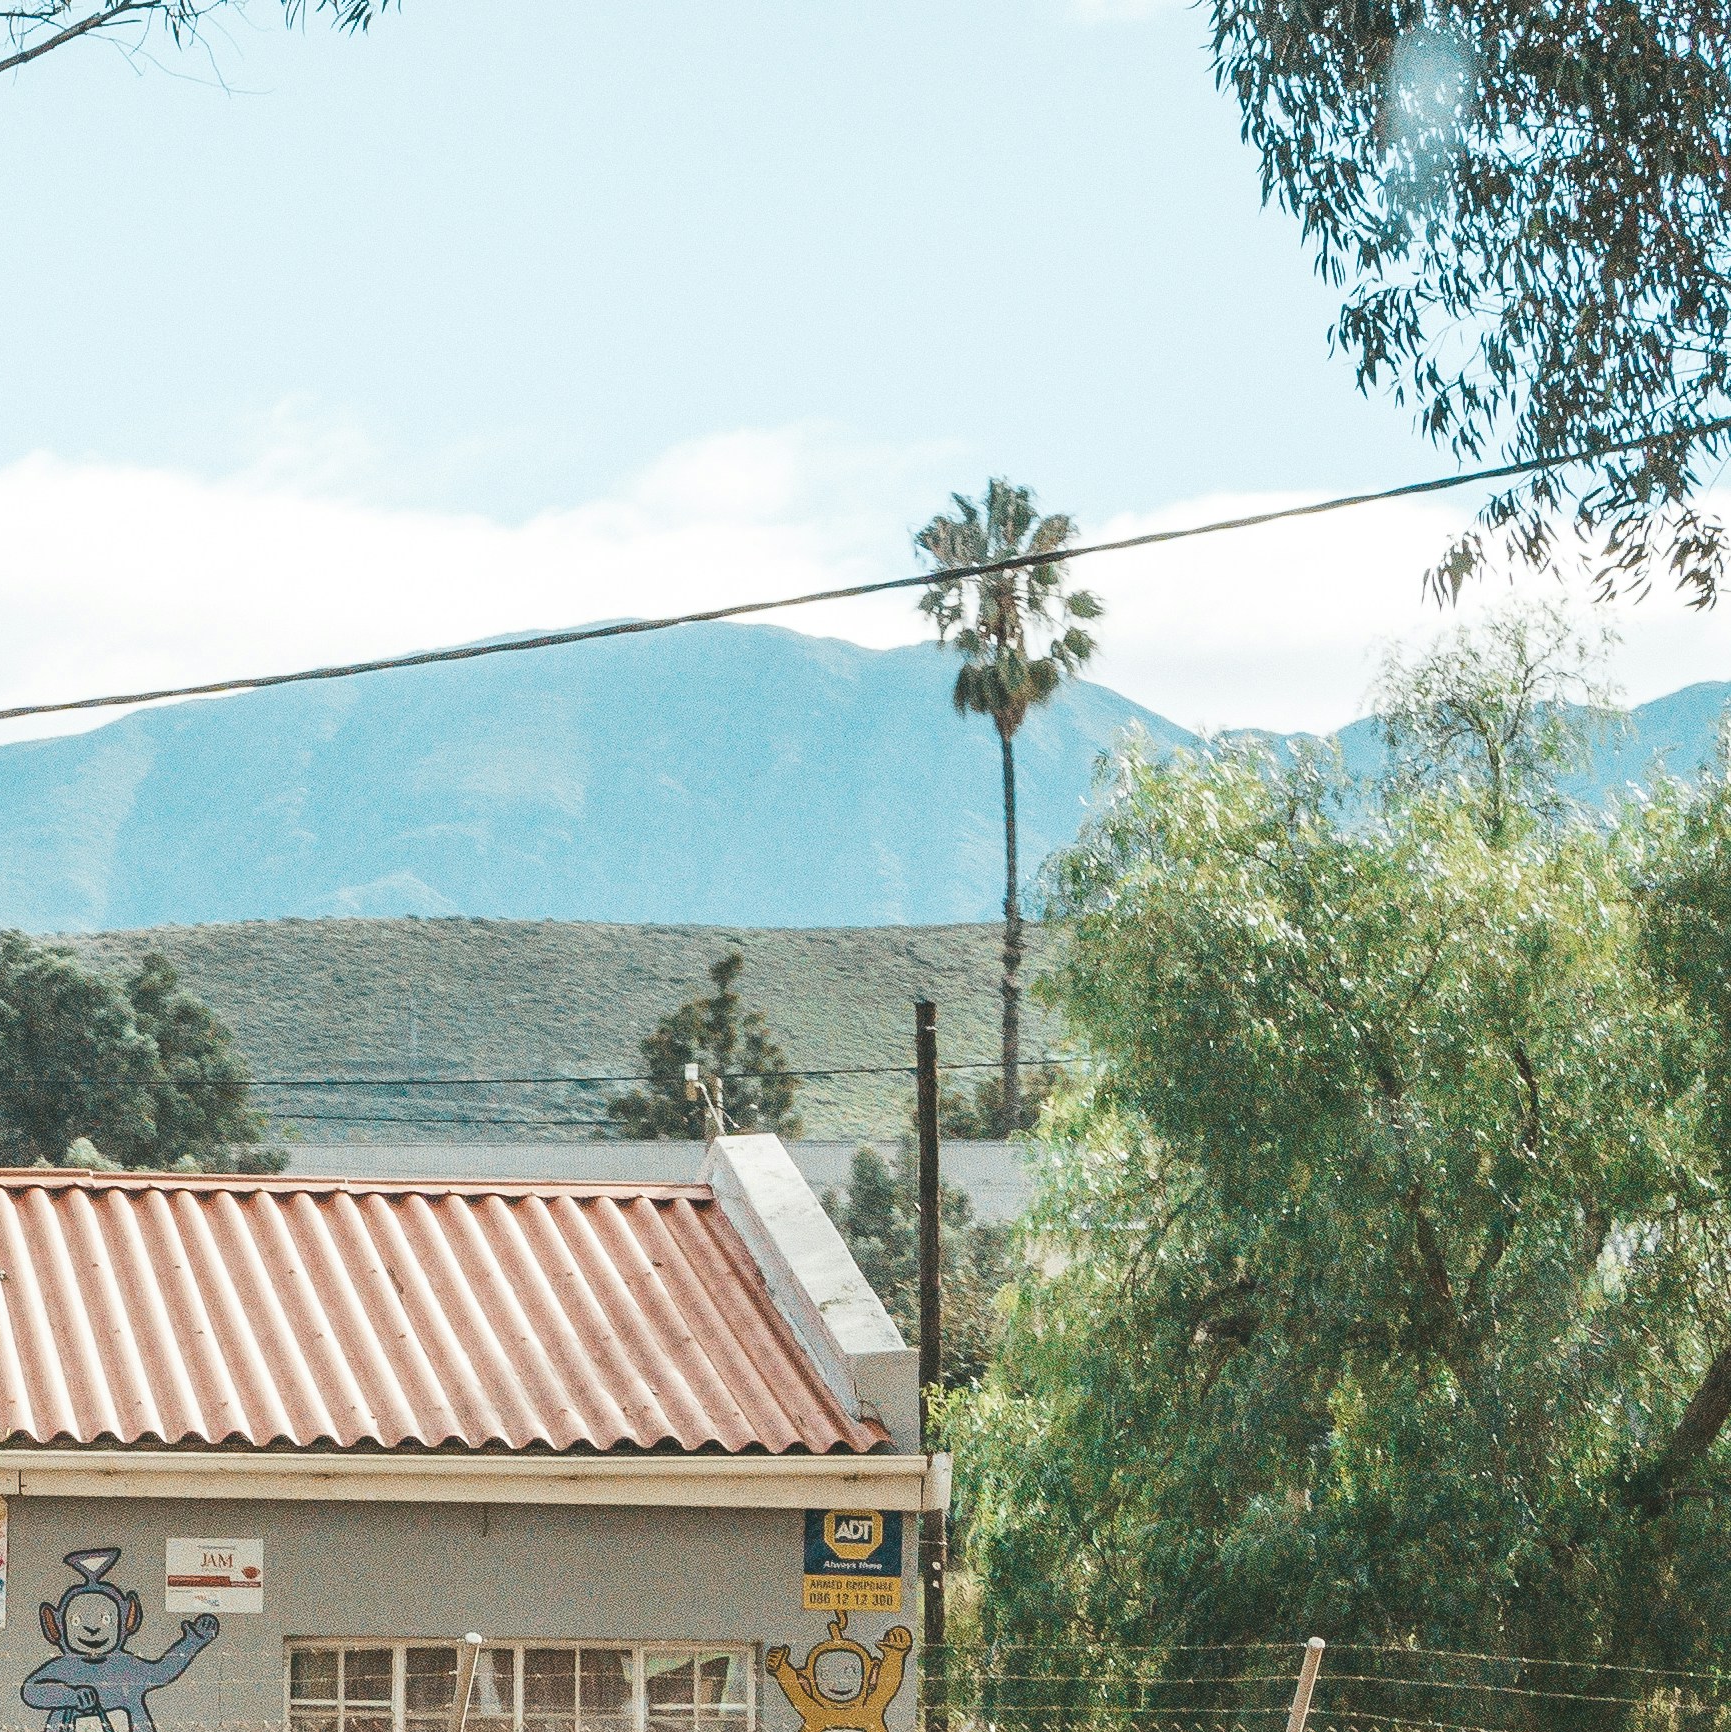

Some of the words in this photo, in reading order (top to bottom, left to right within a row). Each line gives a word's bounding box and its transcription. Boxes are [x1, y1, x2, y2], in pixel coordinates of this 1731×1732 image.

[835, 1520, 873, 1540] ADT
[200, 1552, 234, 1568] JAM
[823, 1560, 857, 1570] Always
[809, 1580, 842, 1589] ARMED
[845, 1580, 893, 1591] RESPONSE
